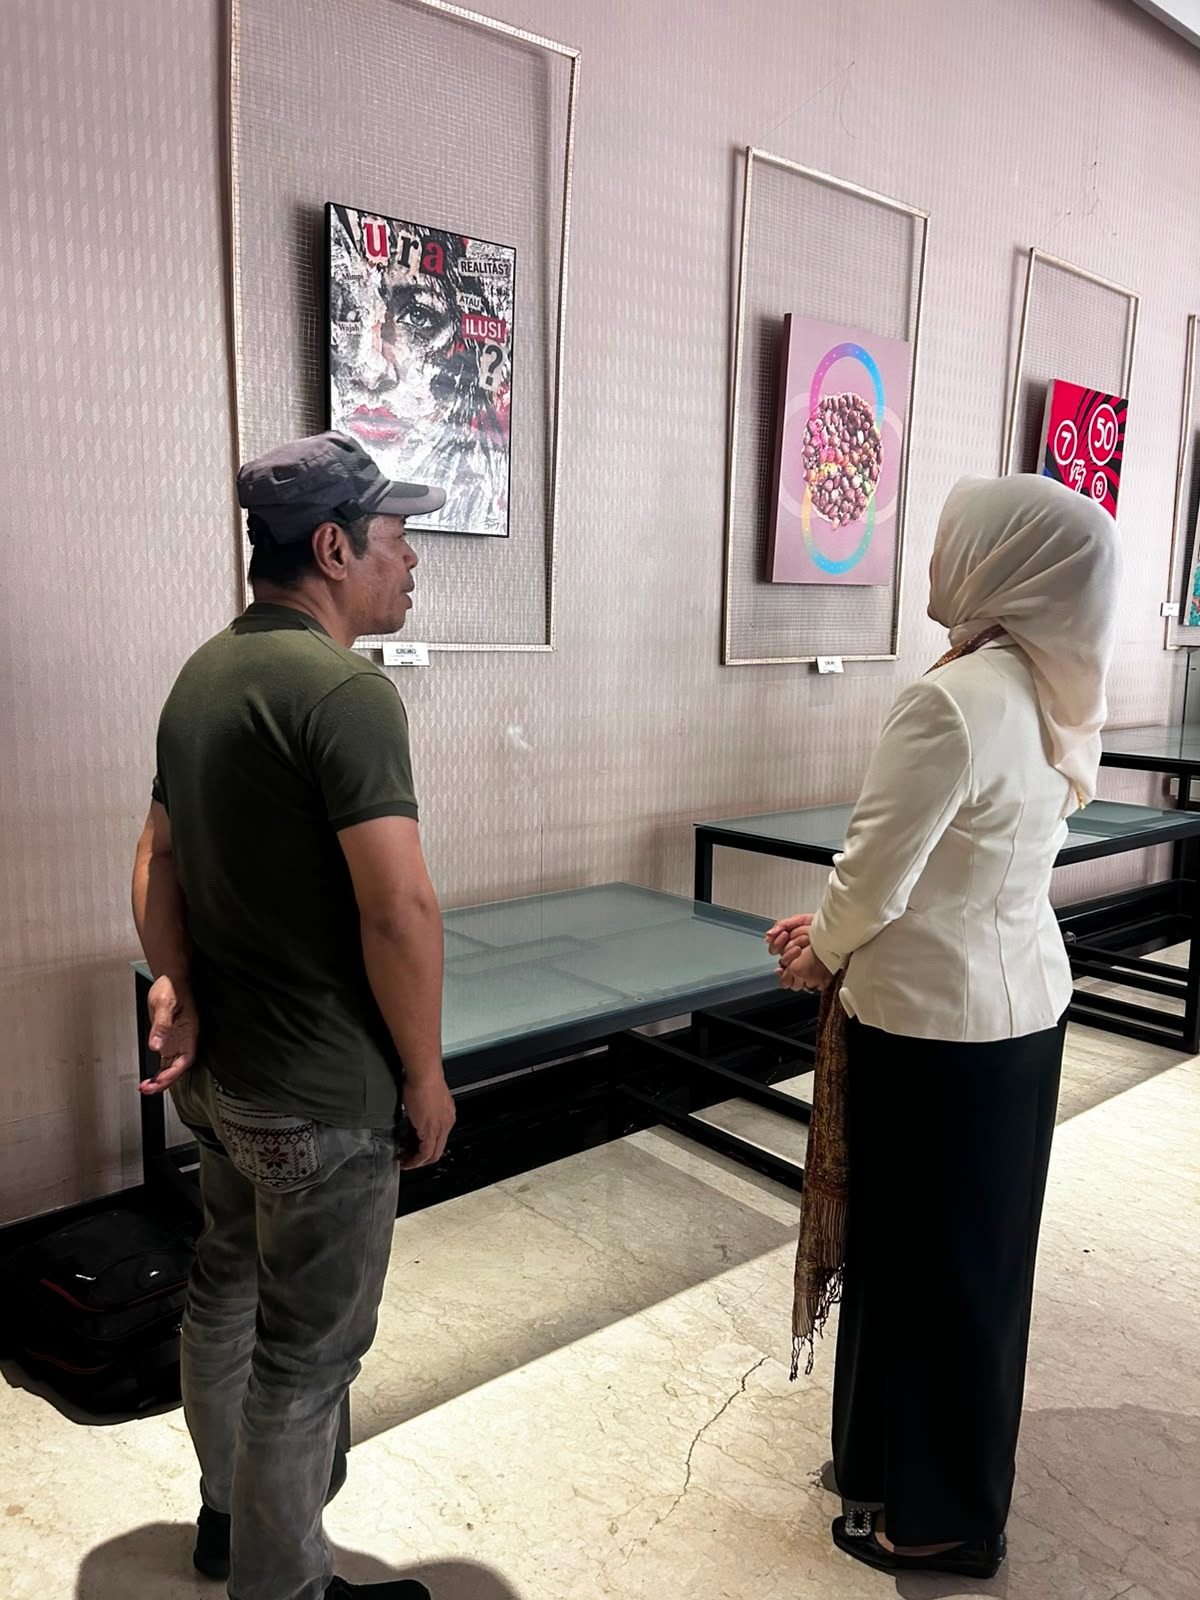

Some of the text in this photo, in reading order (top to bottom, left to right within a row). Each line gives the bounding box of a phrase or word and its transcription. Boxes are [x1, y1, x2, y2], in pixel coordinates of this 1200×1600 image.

[461, 261, 509, 275] REALITAS?
[460, 295, 480, 307] ATAU
[465, 318, 502, 338] ILUSI
[1061, 431, 1072, 456] 7
[1094, 417, 1114, 450] 50
